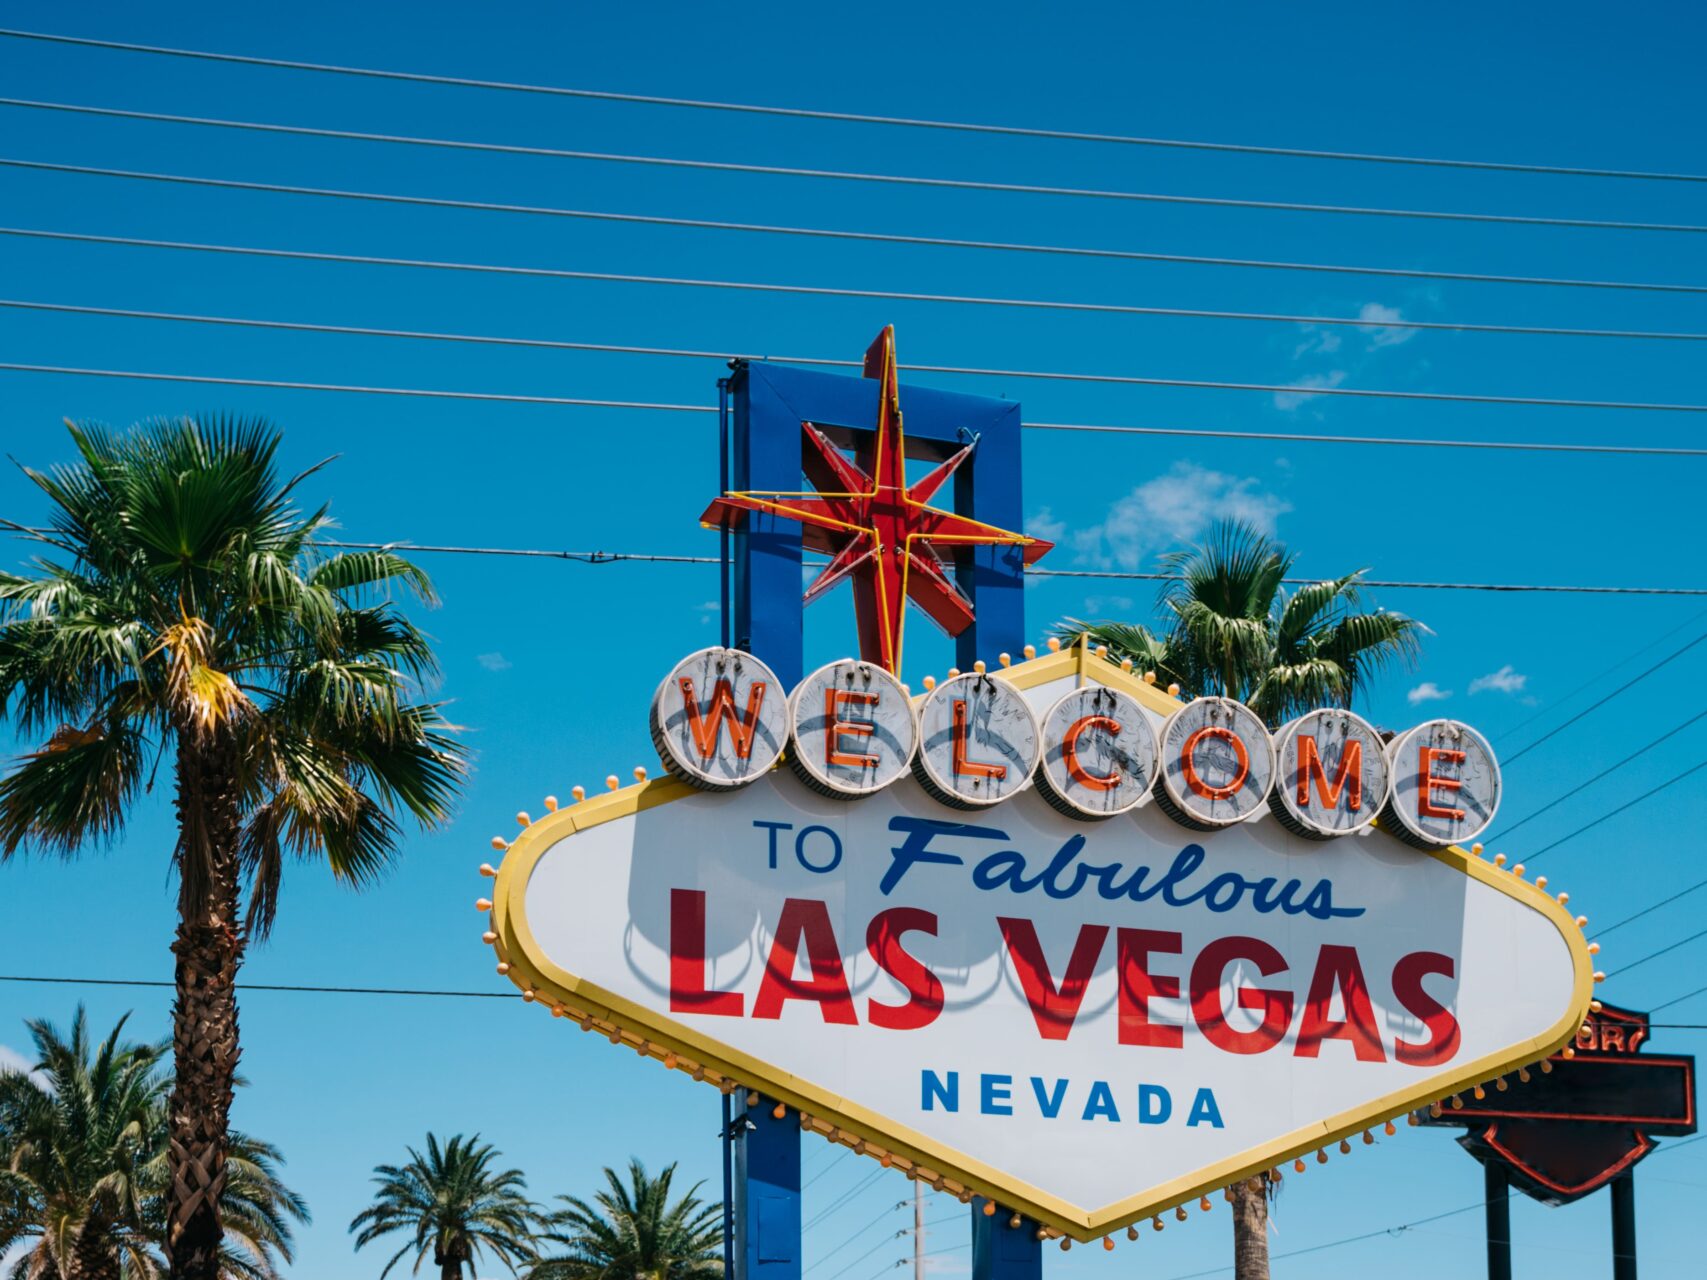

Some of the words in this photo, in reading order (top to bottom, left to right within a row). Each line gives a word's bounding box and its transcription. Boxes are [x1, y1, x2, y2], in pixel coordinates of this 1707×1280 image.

[680, 676, 1466, 820] WELCOME
[753, 820, 842, 874] TO
[880, 816, 1366, 919] Fabulous
[670, 888, 945, 1031] LAS
[996, 916, 1462, 1067] VEGAS
[921, 1069, 1225, 1129] NEVADA
